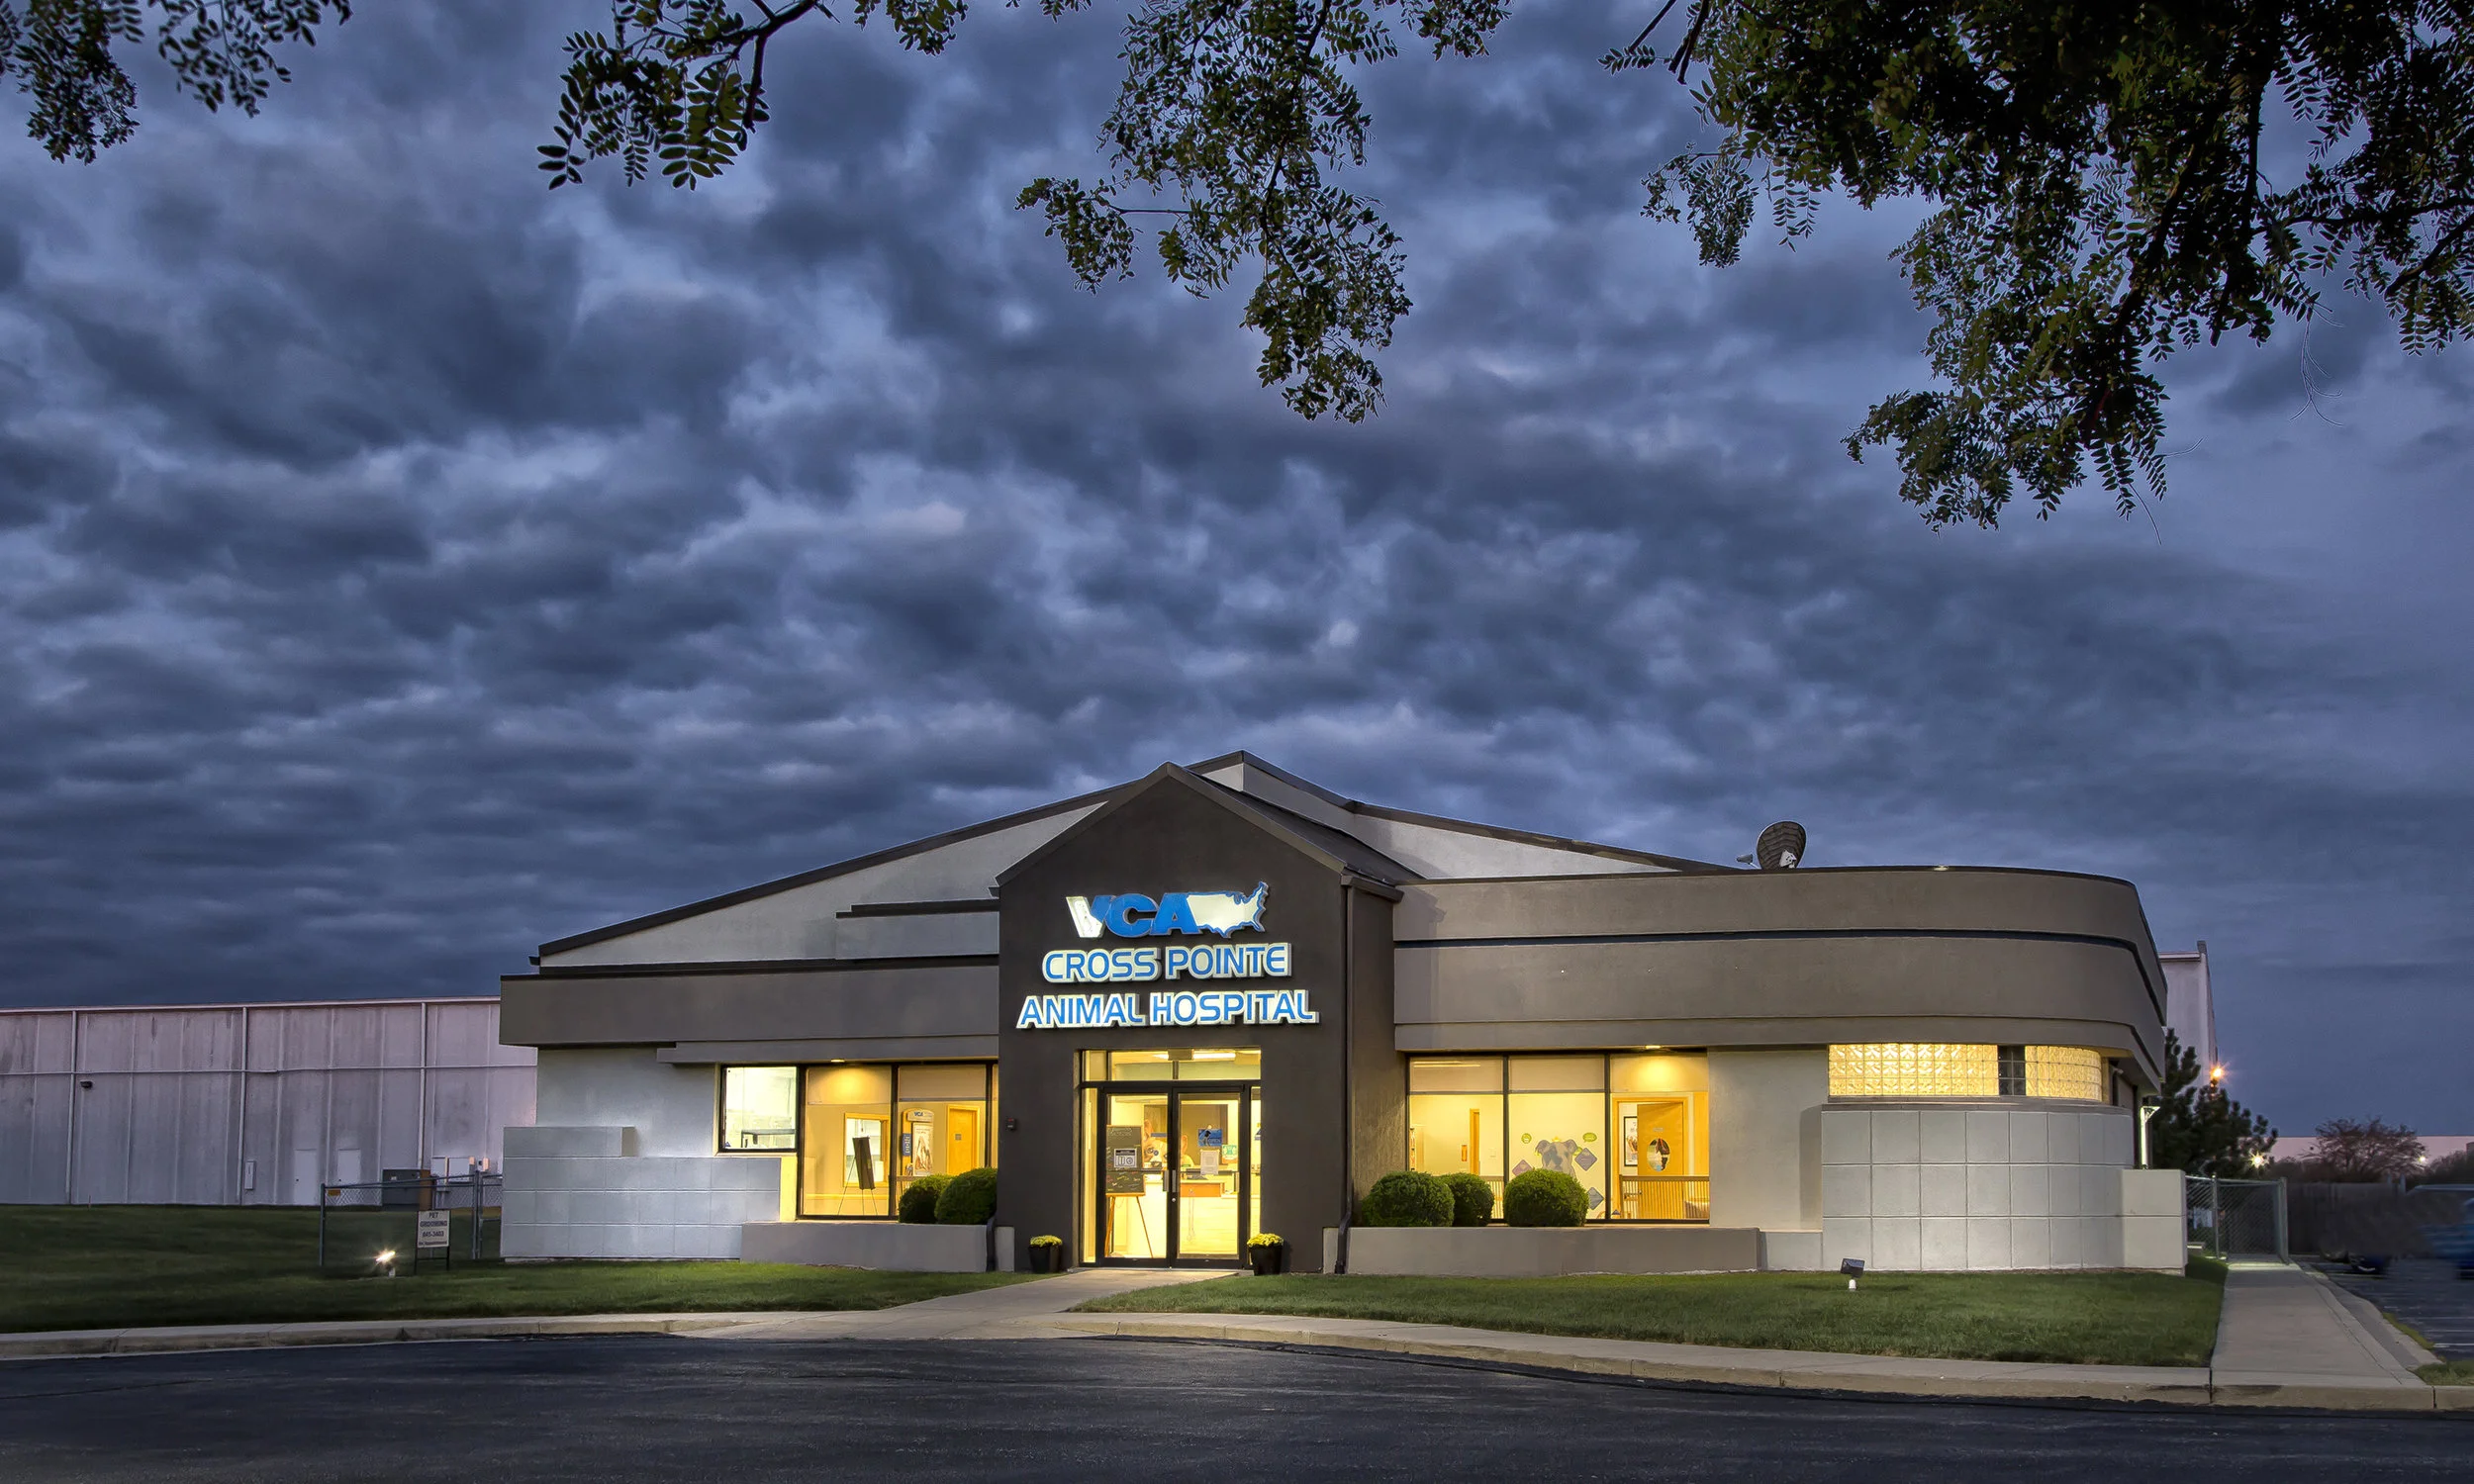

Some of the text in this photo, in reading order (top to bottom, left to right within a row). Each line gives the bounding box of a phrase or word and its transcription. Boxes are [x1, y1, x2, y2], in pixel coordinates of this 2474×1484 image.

[1066, 892, 1202, 938] VCA
[1042, 942, 1291, 982] CROSS POINTE
[1016, 989, 1319, 1028] ANIMAL HOSPITAL
